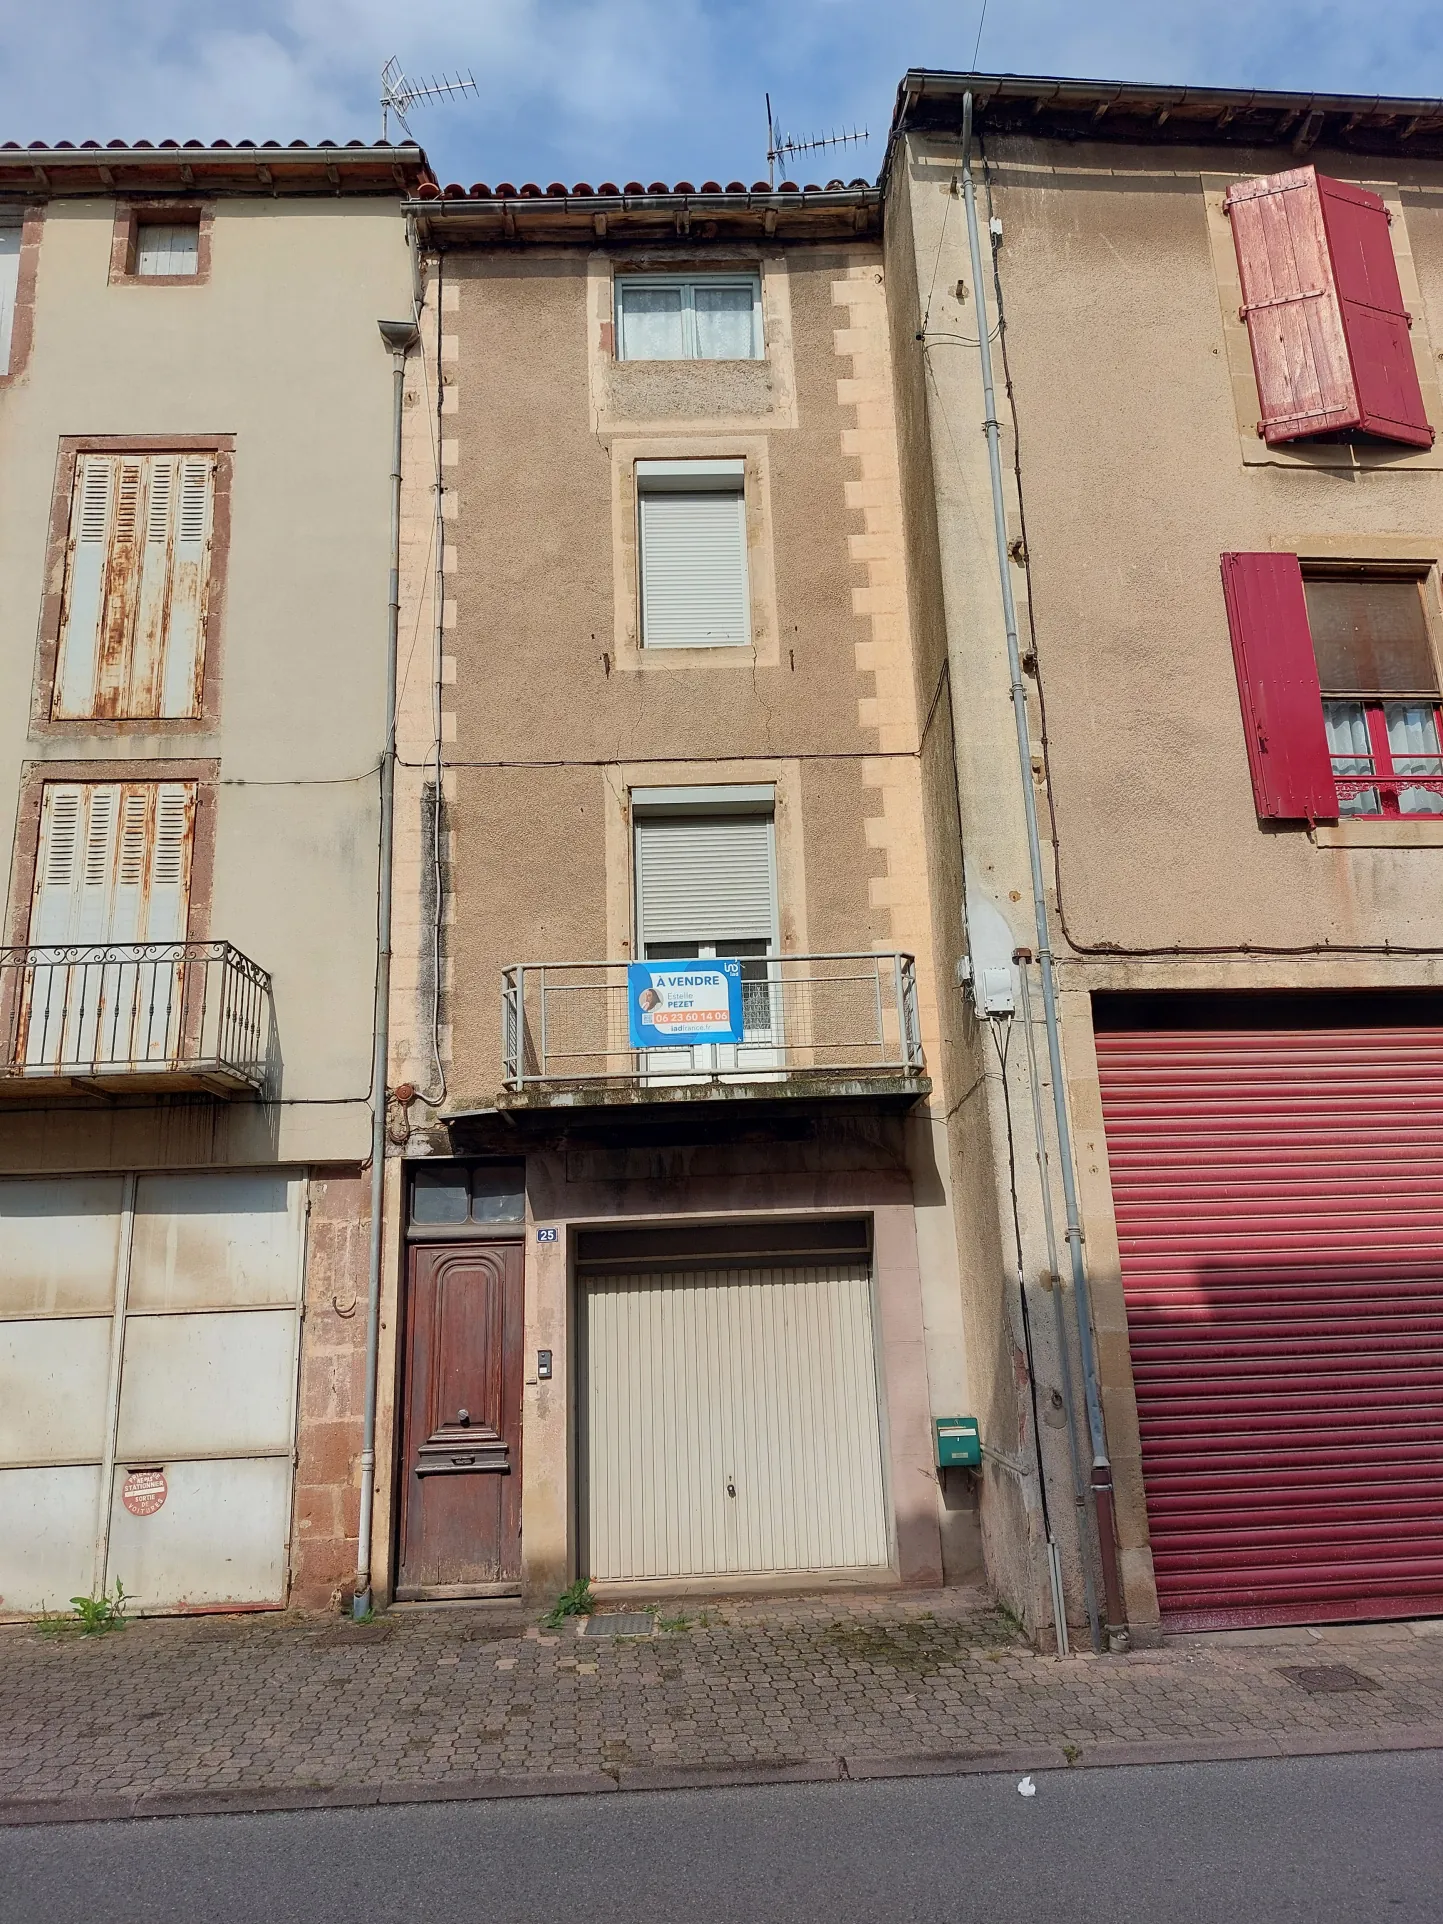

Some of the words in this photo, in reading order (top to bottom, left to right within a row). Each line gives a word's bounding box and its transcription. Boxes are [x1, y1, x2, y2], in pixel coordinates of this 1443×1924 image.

[657, 976, 666, 987] À
[668, 975, 719, 987] VENDRE
[667, 992, 693, 1000] Estelle
[667, 1000, 694, 1008] PEZET
[656, 1014, 668, 1023] 06
[671, 1014, 683, 1022] 23
[685, 1013, 698, 1021] 60
[700, 1012, 712, 1020] 14
[715, 1011, 728, 1019] 06
[671, 1024, 711, 1032] iadfrance.fr
[540, 1230, 554, 1240] 25
[124, 1480, 164, 1491] STATIONNER
[135, 1494, 156, 1502] SORTIE
[128, 1498, 163, 1514] VOITURES
